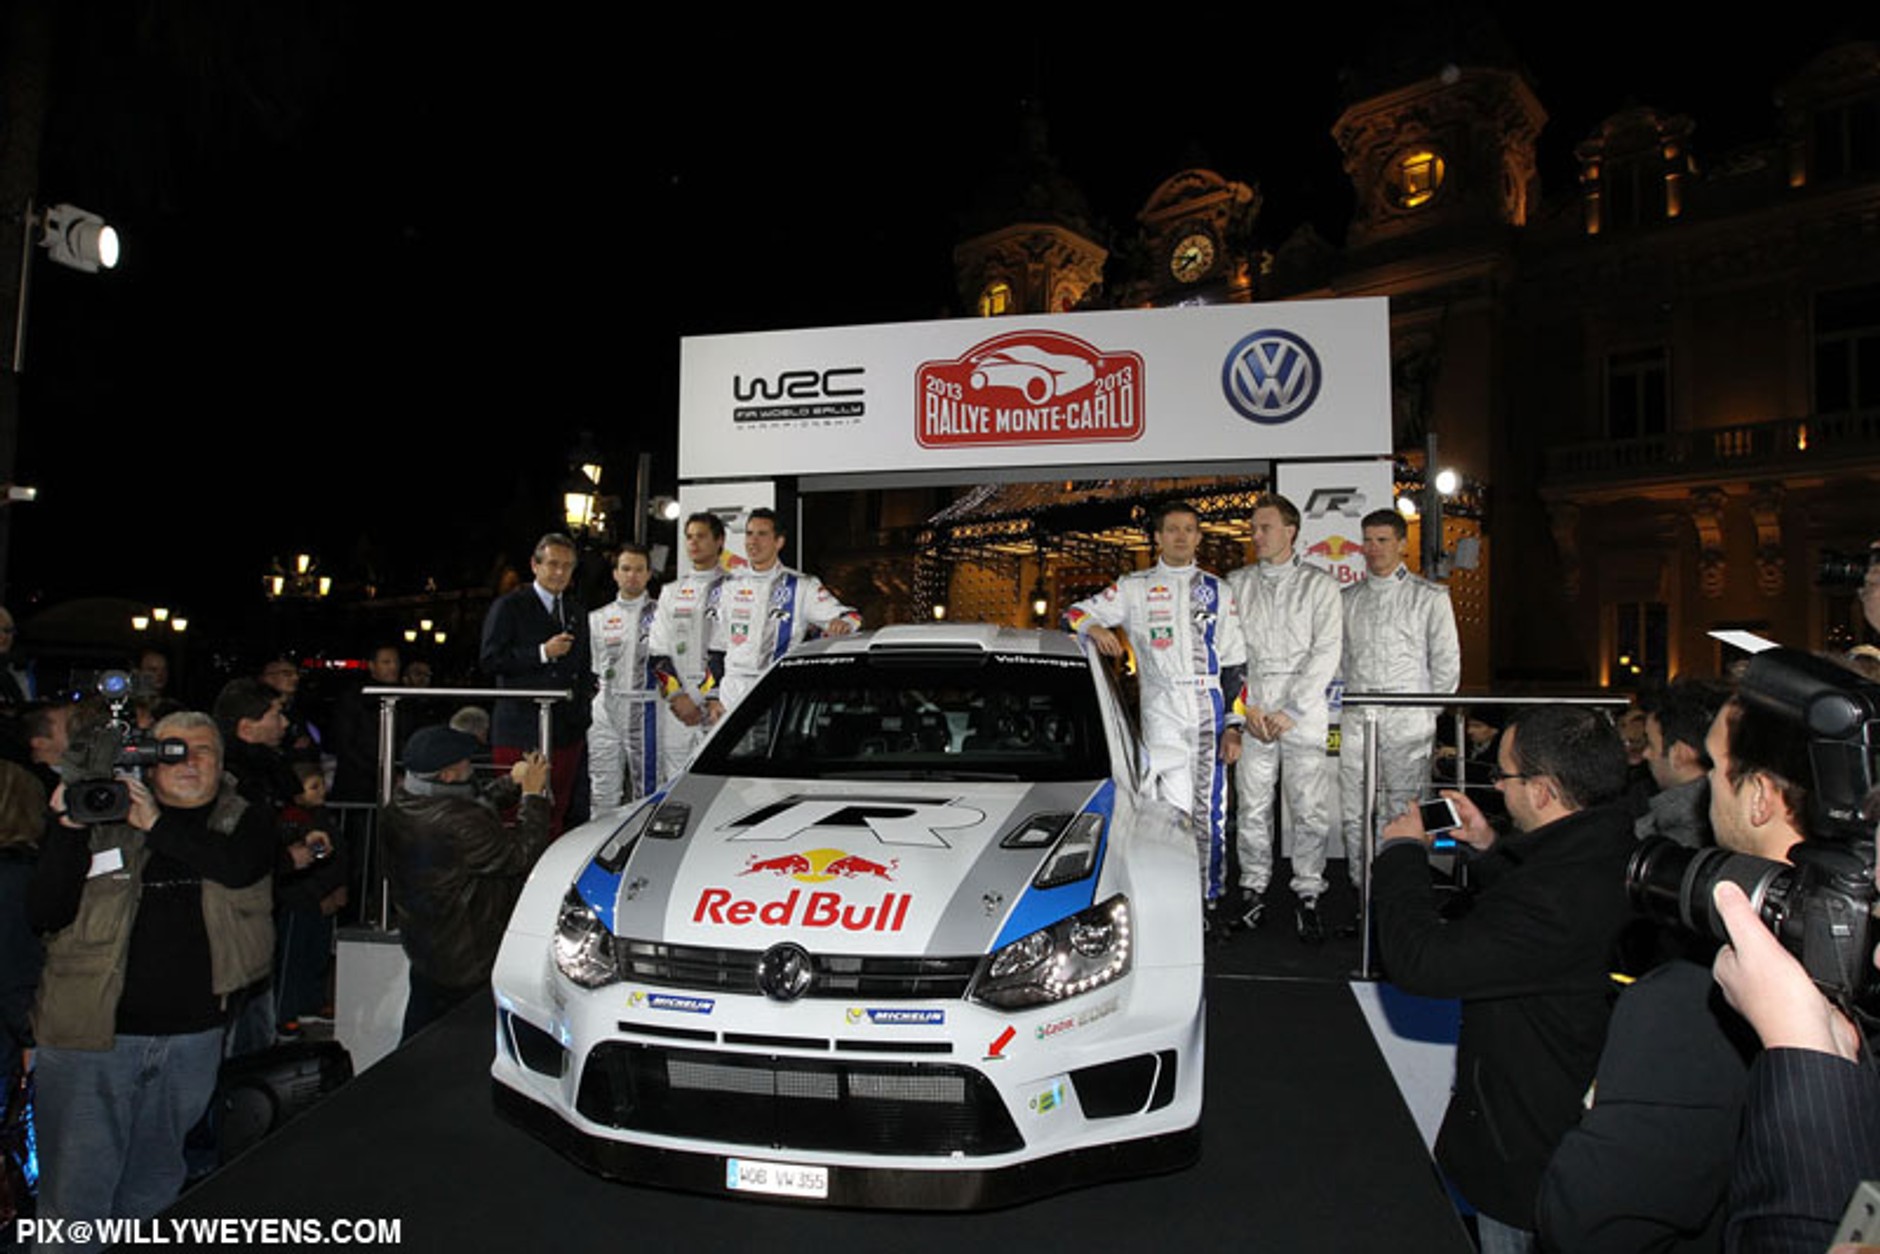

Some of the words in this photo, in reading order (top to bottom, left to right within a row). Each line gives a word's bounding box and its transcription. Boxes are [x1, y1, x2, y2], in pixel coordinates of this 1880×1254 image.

[733, 367, 865, 401] WRC
[926, 375, 963, 400] 2013
[1094, 366, 1133, 396] 2013
[926, 392, 990, 435] RALLYE
[994, 654, 1087, 668] Volkswagen
[693, 888, 801, 925] Red
[802, 891, 912, 931] Bull
[653, 997, 713, 1011] MICHELIN
[874, 1011, 942, 1023] MICHELIN
